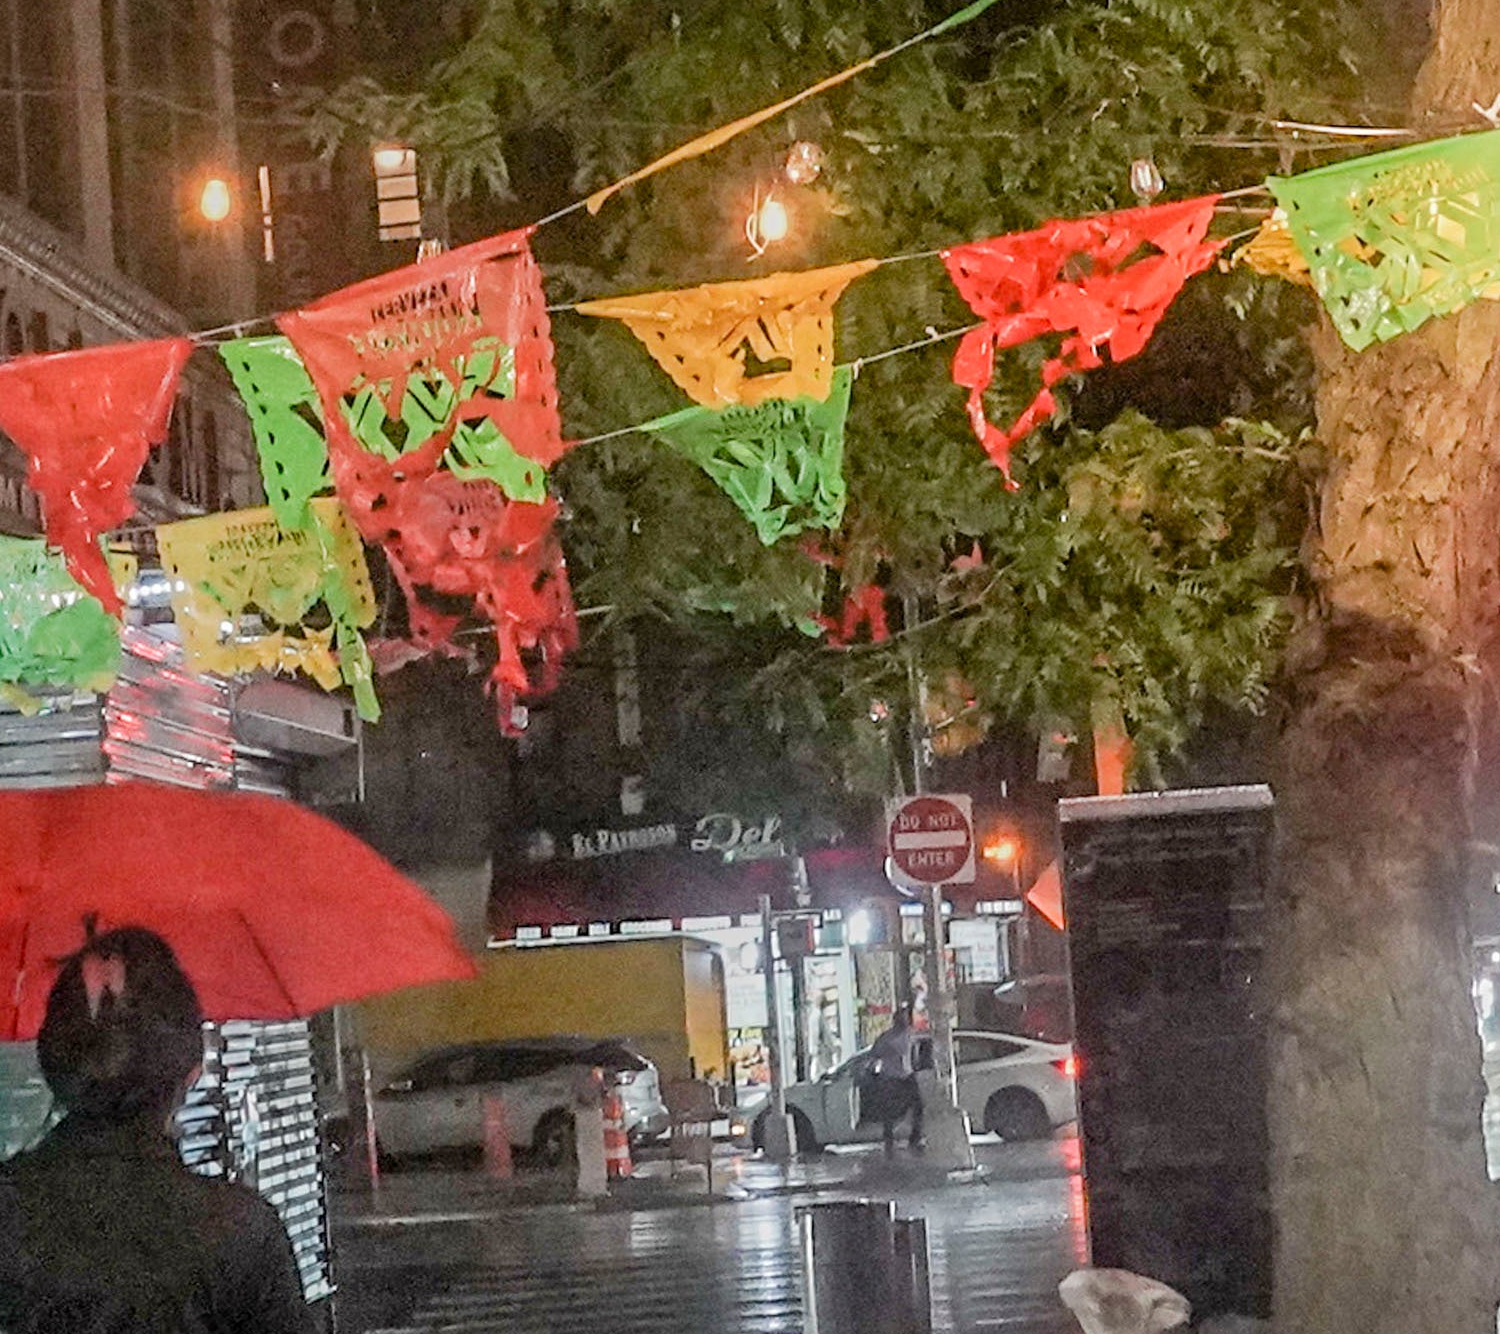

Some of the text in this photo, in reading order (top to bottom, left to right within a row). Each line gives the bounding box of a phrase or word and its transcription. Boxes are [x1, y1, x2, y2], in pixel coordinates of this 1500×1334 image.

[899, 811, 959, 830] DO NOT
[908, 850, 955, 867] ENTER
